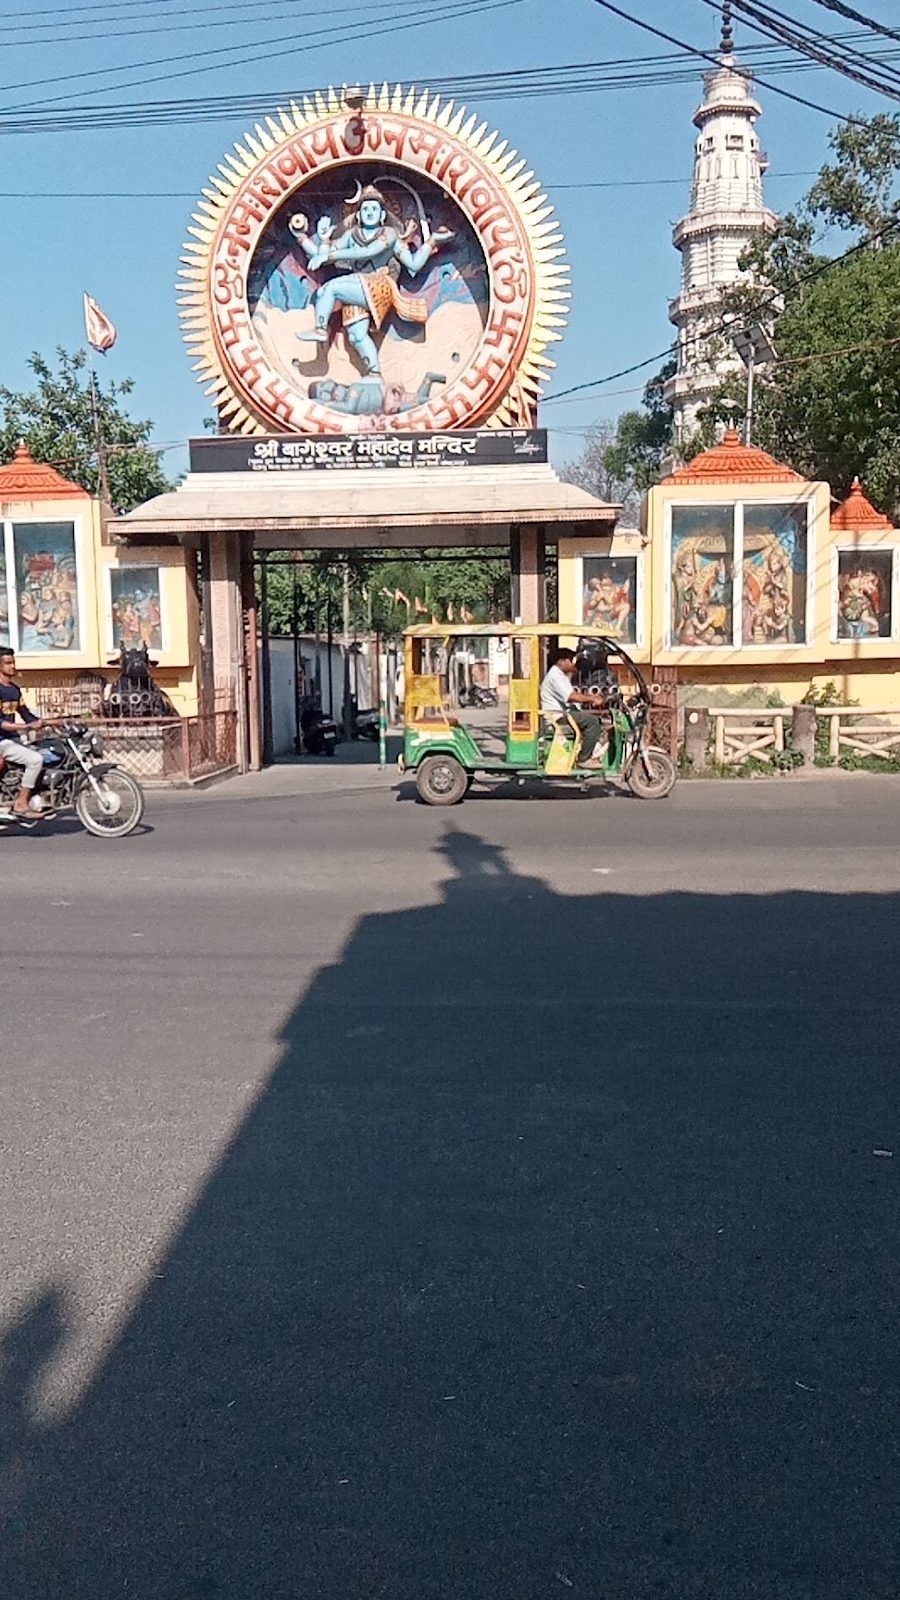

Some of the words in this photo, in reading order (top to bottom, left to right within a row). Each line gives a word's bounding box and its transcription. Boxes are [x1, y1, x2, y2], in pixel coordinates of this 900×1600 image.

[253, 439, 279, 459] श्री
[282, 438, 354, 459] बागेश्वर
[357, 437, 413, 456] महादेव
[417, 435, 477, 455] मन्दिर
